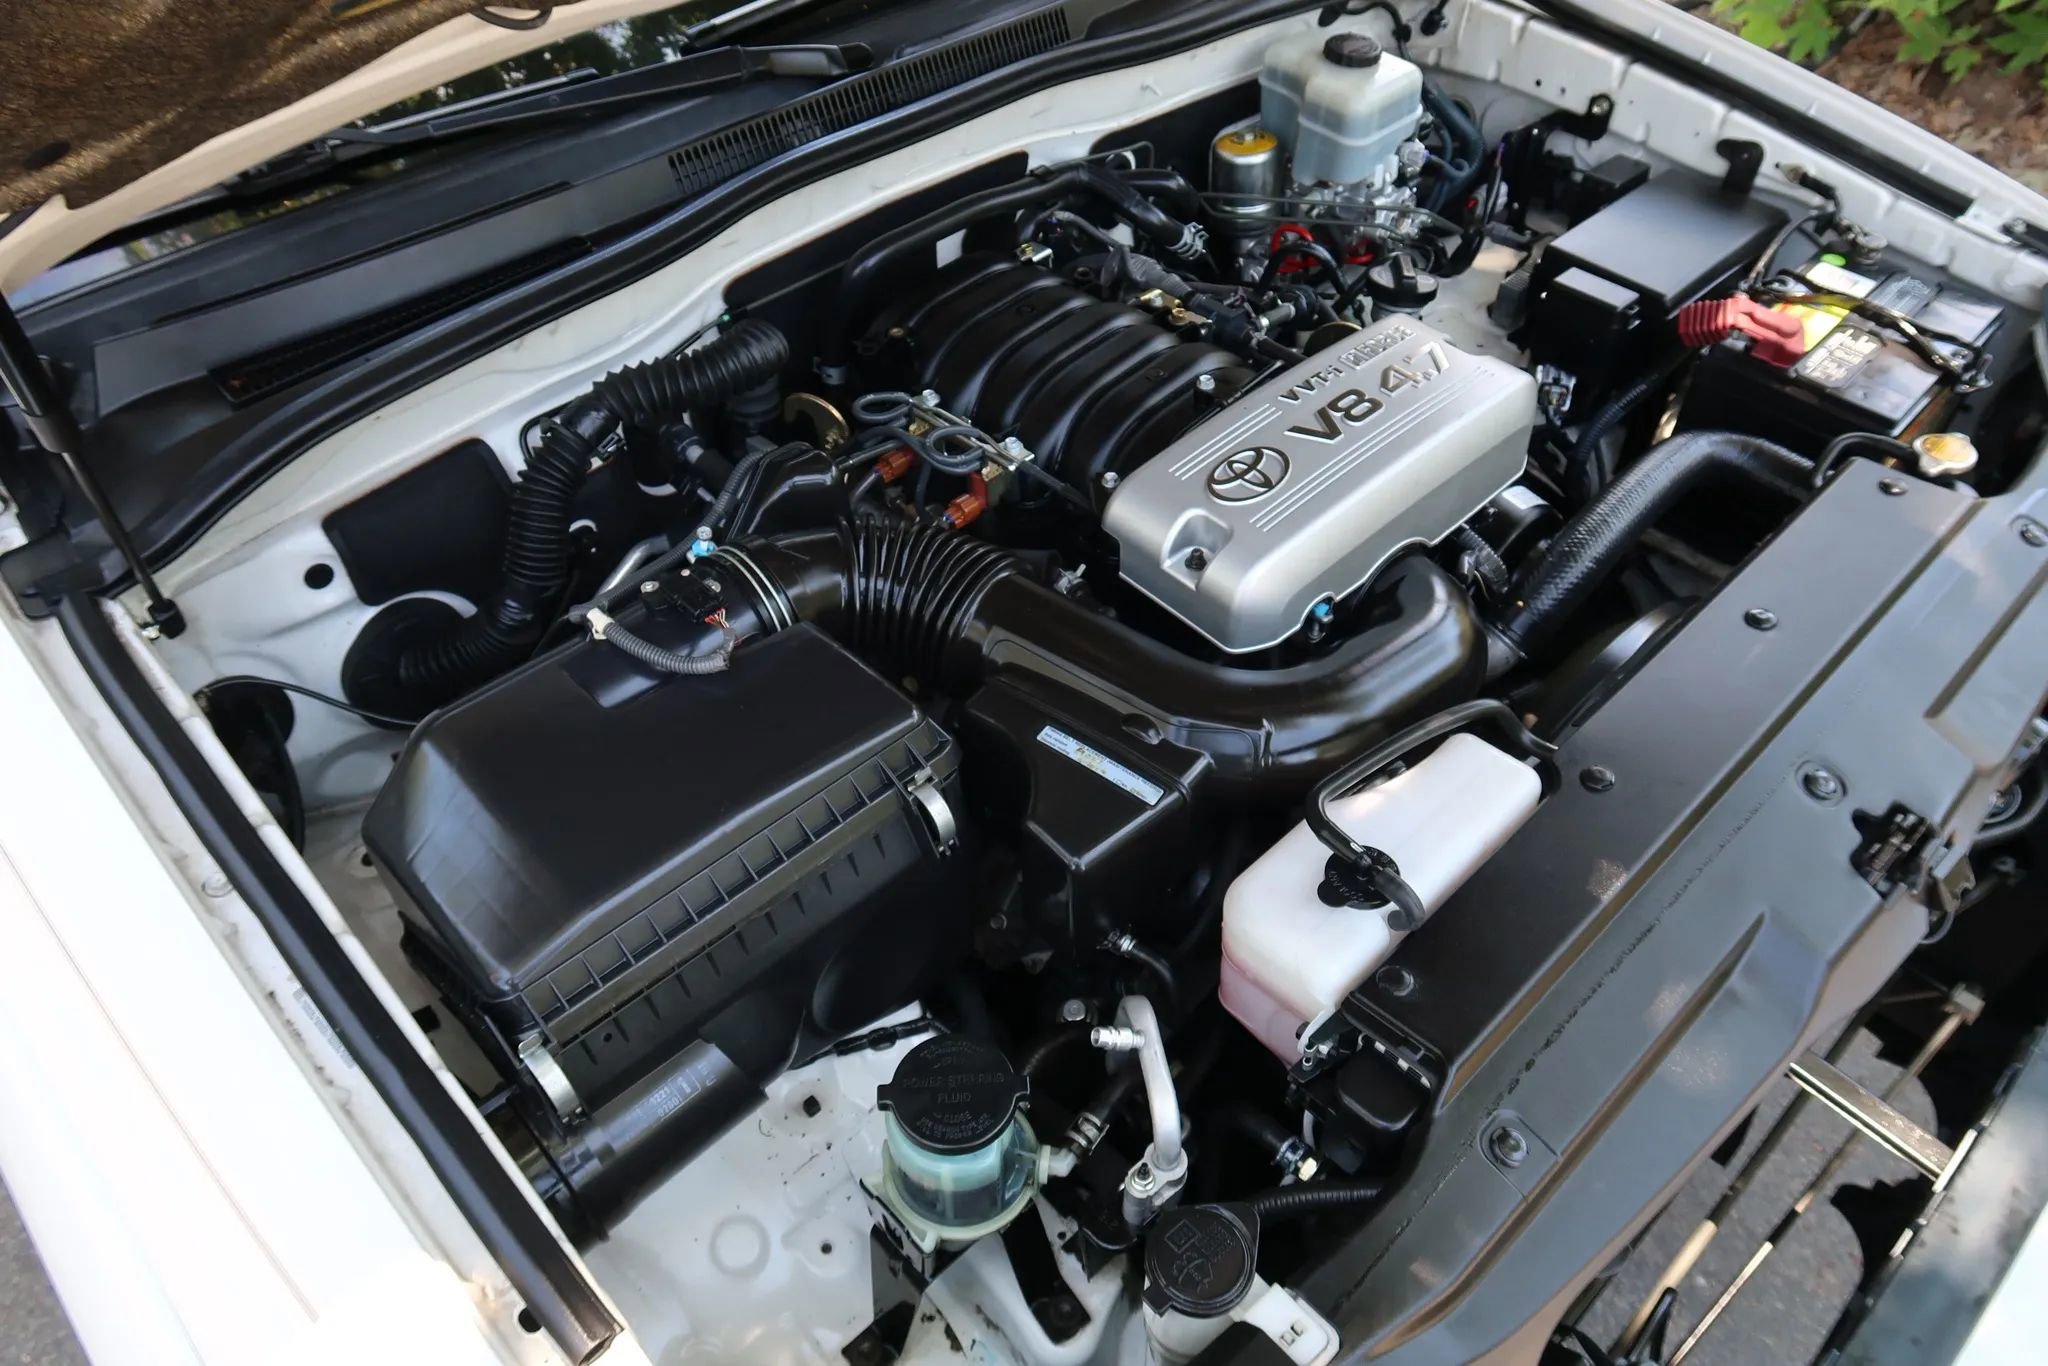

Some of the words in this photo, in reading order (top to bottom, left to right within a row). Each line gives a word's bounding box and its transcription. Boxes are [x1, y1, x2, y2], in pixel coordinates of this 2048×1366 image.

[1278, 364, 1344, 404] VVT-i
[1283, 388, 1385, 444] V8
[1380, 341, 1450, 397] 4.7
[937, 1092, 972, 1104] FLUID
